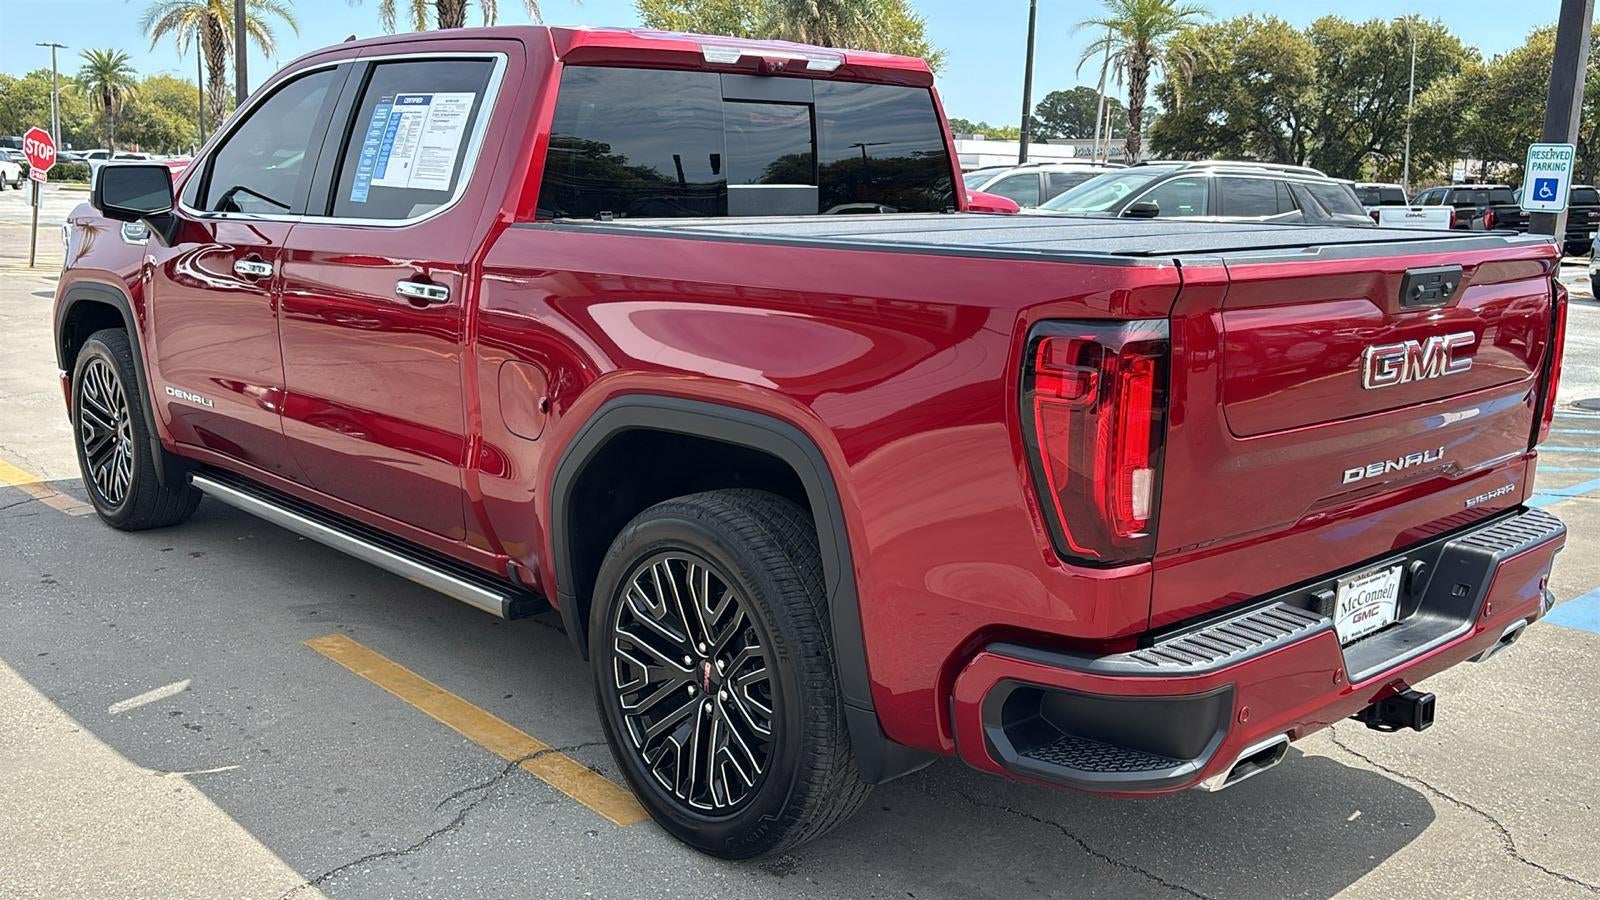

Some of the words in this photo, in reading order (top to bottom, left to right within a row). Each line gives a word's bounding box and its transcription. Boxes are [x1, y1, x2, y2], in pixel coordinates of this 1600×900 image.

[26, 138, 54, 160] STOP
[1531, 150, 1571, 160] RESERVED
[1532, 162, 1566, 171] PARKING
[1361, 331, 1476, 390] GMC
[165, 385, 215, 408] DENALI
[1342, 446, 1445, 485] DENALI
[1465, 483, 1516, 508] SIERRA
[1340, 582, 1395, 618] McConnell
[1352, 605, 1381, 624] GMC
